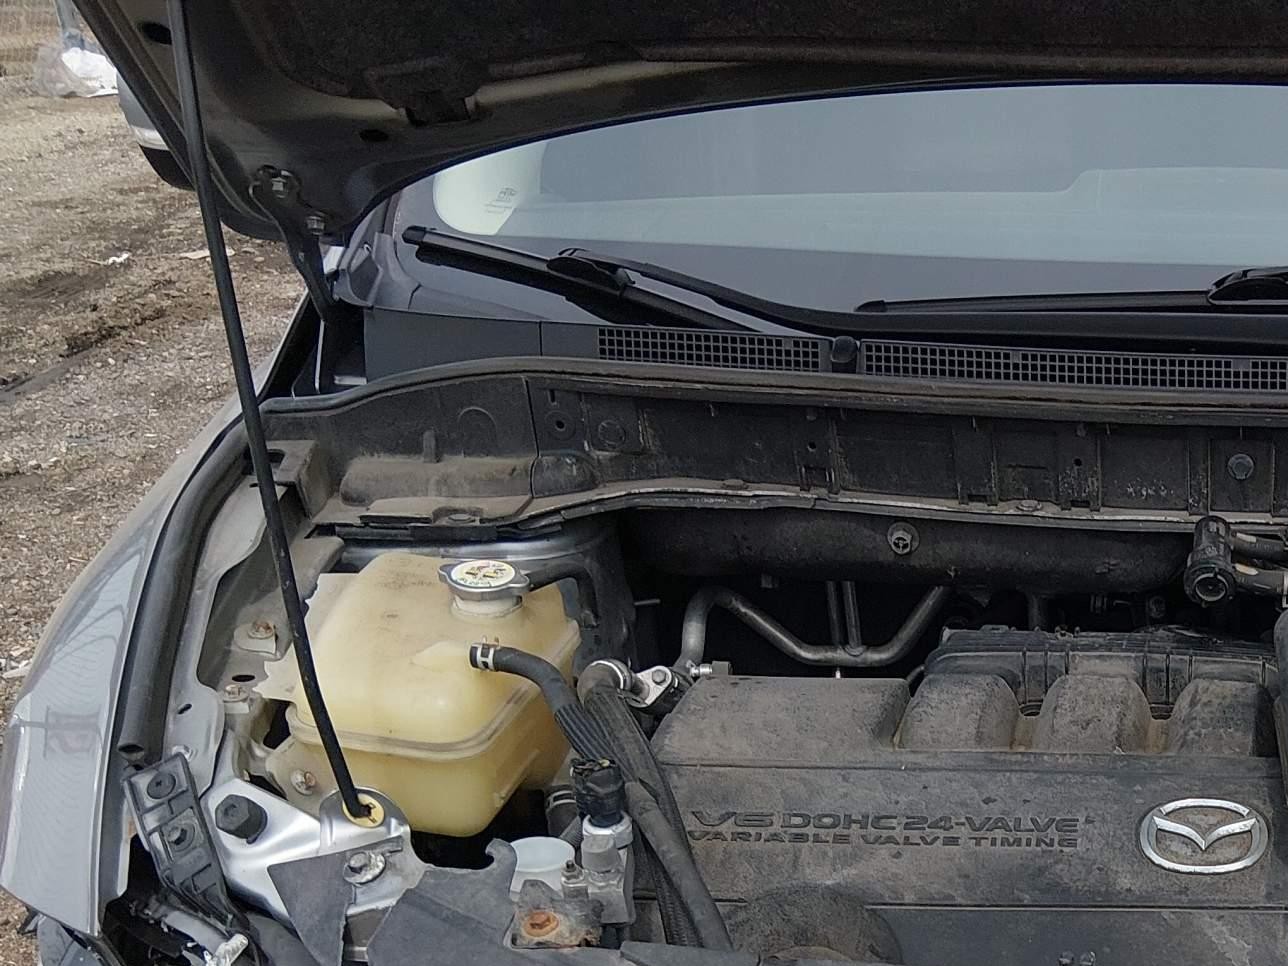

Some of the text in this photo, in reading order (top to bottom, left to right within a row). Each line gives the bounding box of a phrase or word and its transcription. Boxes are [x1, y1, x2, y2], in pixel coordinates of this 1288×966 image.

[691, 810, 1080, 833] V6 DOHC 24-VALVE
[687, 830, 1078, 848] VARIABLE VALVE TIMING
